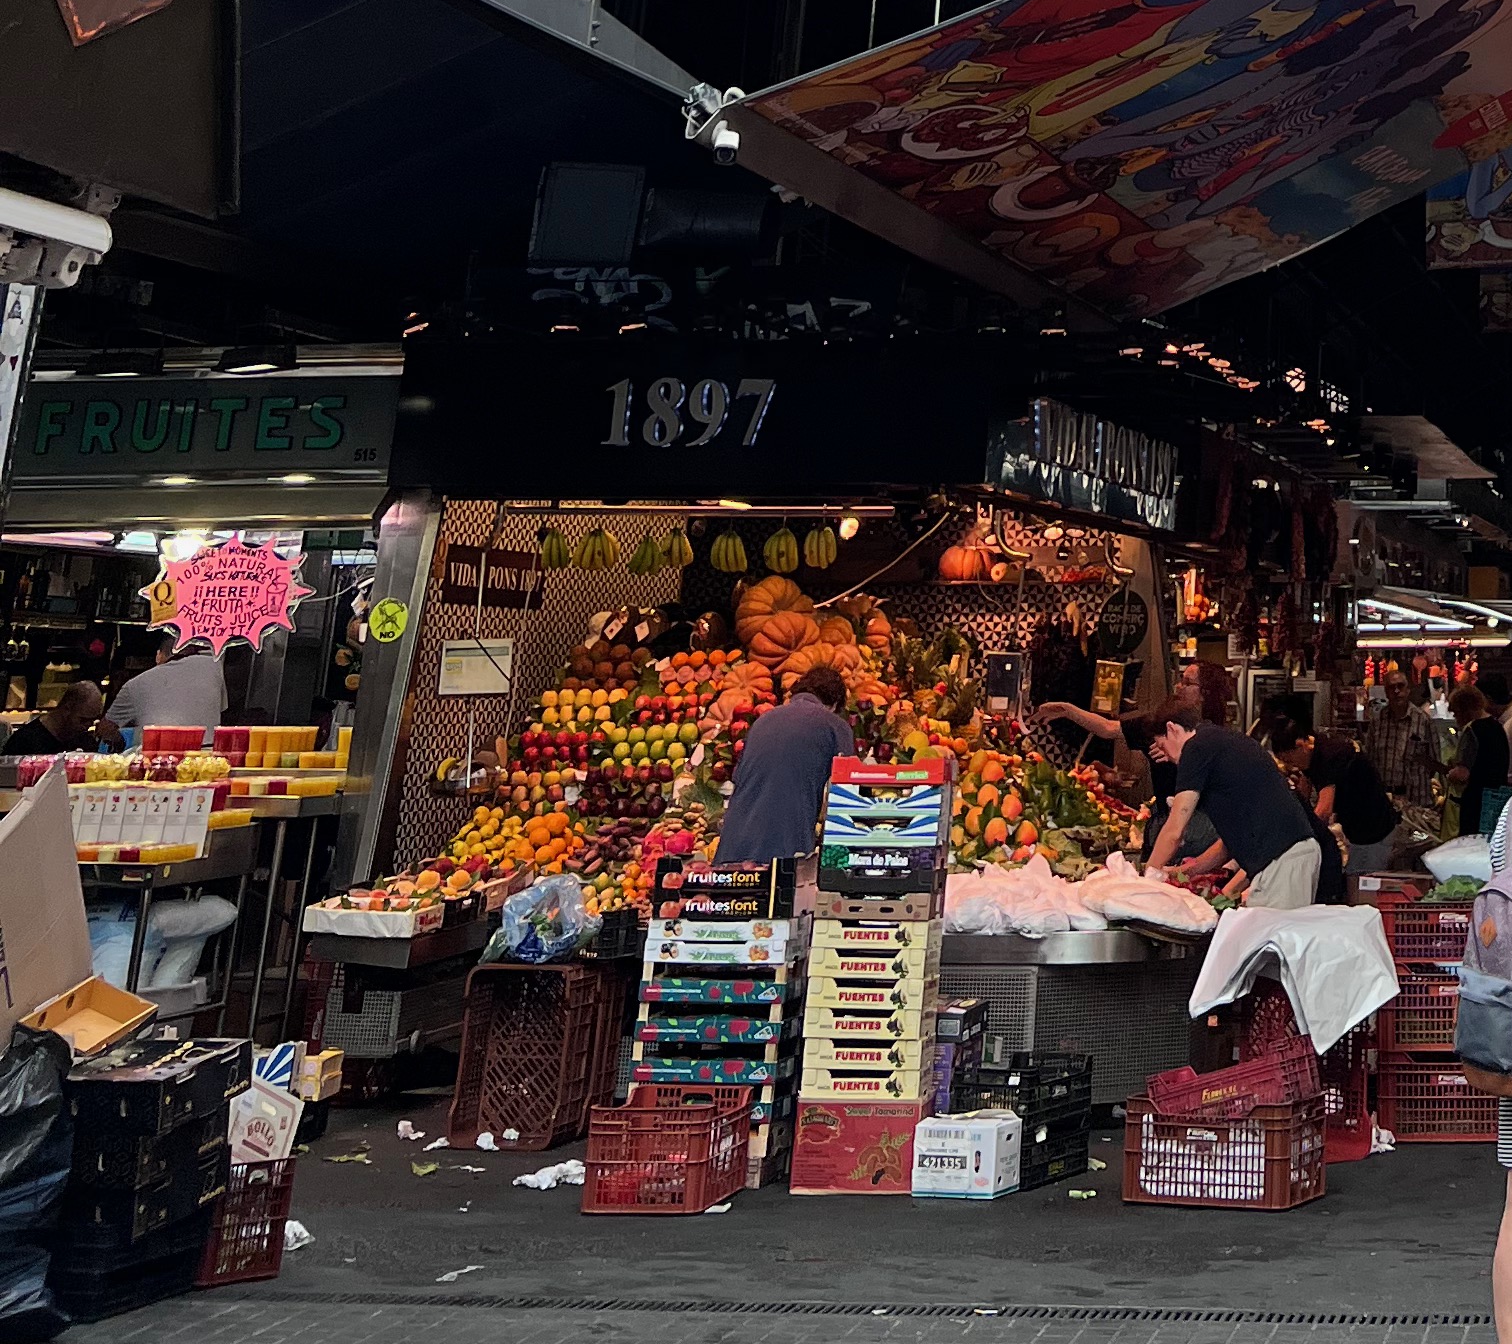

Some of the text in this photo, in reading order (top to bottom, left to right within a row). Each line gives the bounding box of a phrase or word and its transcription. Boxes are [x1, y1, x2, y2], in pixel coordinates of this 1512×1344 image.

[600, 377, 777, 448] 1897
[34, 395, 348, 455] FRUITES
[353, 447, 377, 462] 515
[450, 561, 542, 593] VIDA PONS 1897
[201, 598, 244, 614] FRUTA
[178, 604, 268, 626] FRUITS JUICE
[379, 631, 396, 640] NO
[687, 871, 760, 884] fruitesfont
[685, 899, 758, 912] fruitesfont
[843, 930, 889, 941] FUENTES
[840, 961, 886, 972] FUENTES
[838, 992, 885, 1002] FUENTES
[834, 1020, 881, 1030] FUENTES
[835, 1051, 882, 1061] FUENTES
[833, 1081, 880, 1092] FUENTES
[874, 1106, 914, 1116] Tamarind
[247, 1121, 275, 1147] BOLLO
